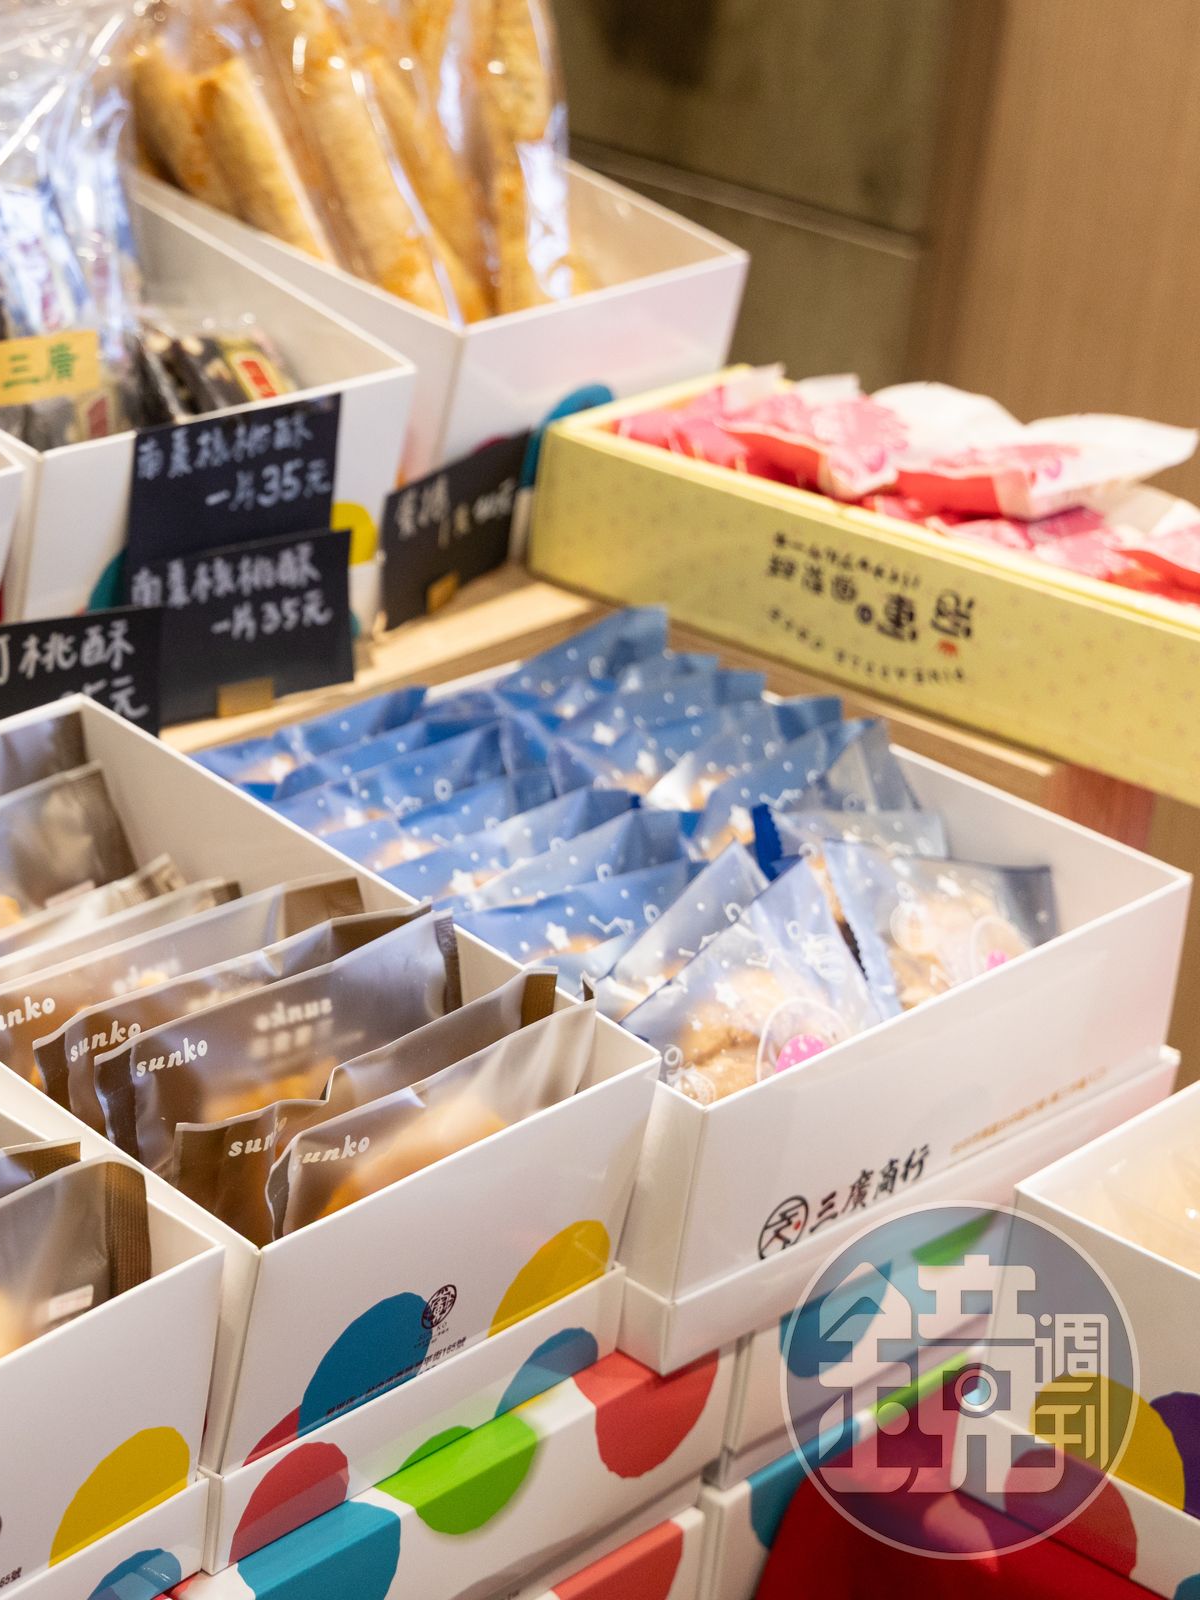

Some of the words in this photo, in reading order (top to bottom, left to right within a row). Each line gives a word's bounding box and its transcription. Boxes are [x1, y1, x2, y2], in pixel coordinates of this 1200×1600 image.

[69, 1020, 142, 1063] sunko
[135, 1037, 208, 1078] sunko
[809, 1144, 931, 1234] 三廣商行
